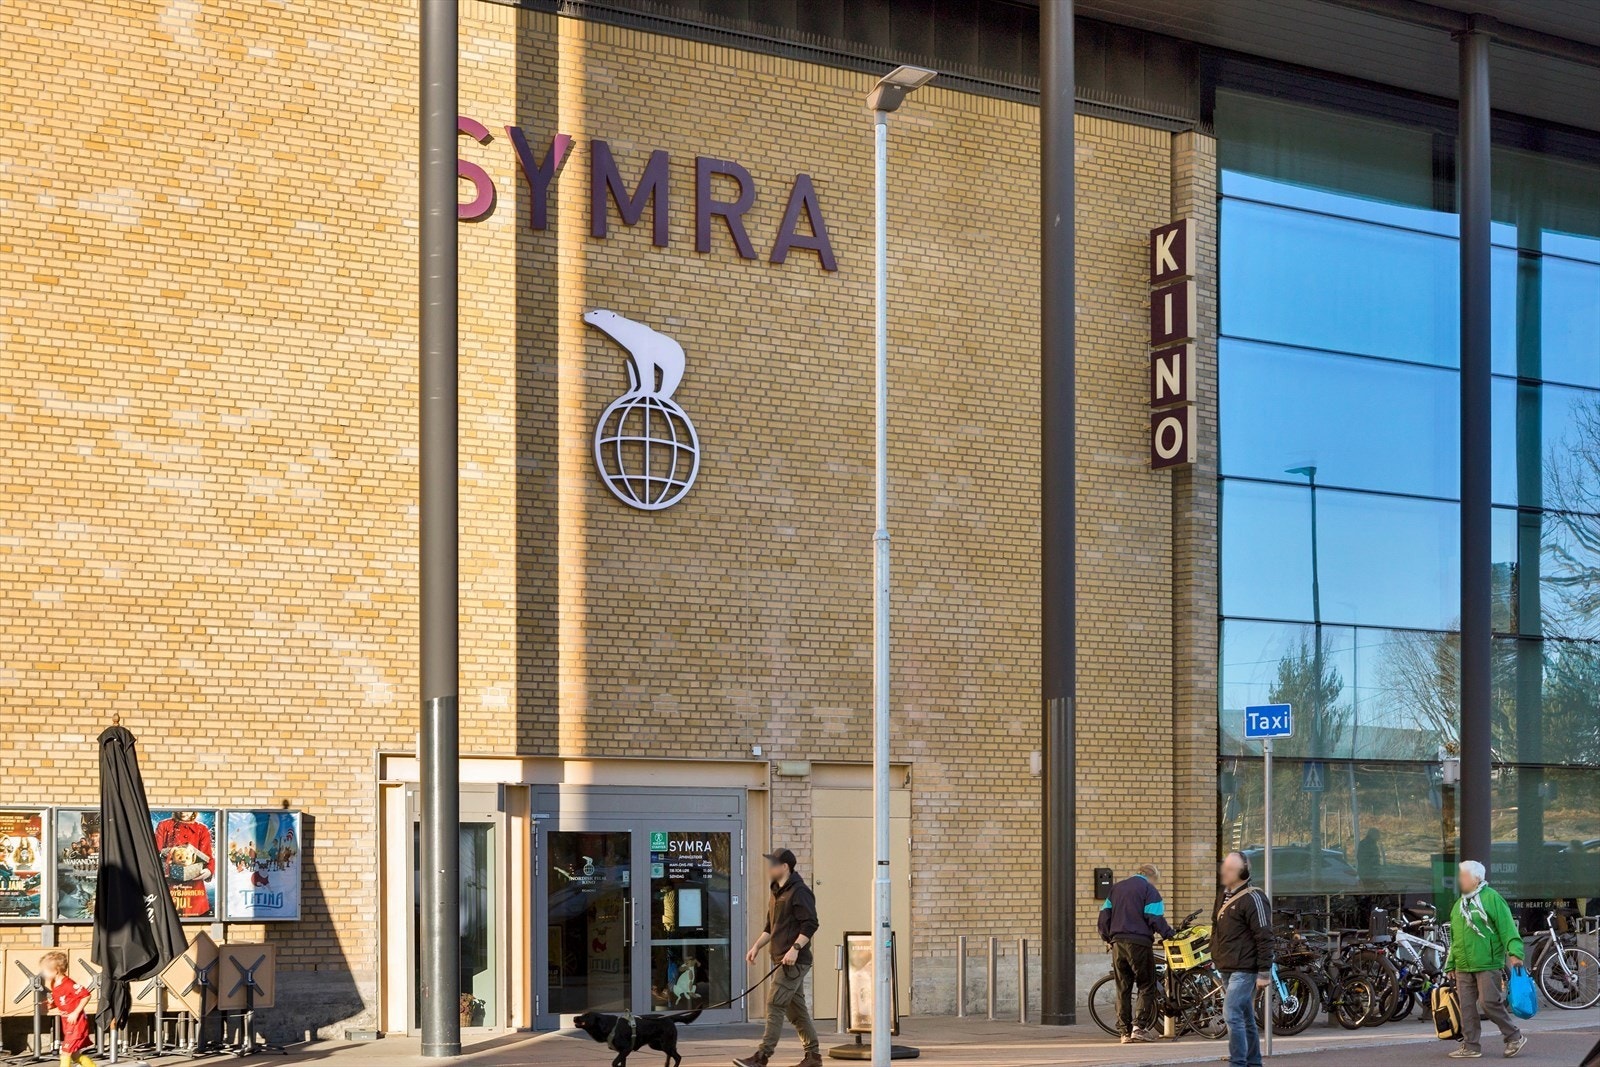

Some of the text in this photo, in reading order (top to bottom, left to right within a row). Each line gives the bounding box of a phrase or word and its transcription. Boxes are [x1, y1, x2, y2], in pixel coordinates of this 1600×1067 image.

[458, 115, 838, 272] SYMRA
[1154, 228, 1184, 460] KINO
[1248, 711, 1288, 730] Taxi
[669, 840, 713, 852] SYMRA
[172, 896, 193, 911] JUL
[239, 890, 284, 909] TITINA
[1514, 901, 1524, 909] THE
[1525, 901, 1543, 909] HEART
